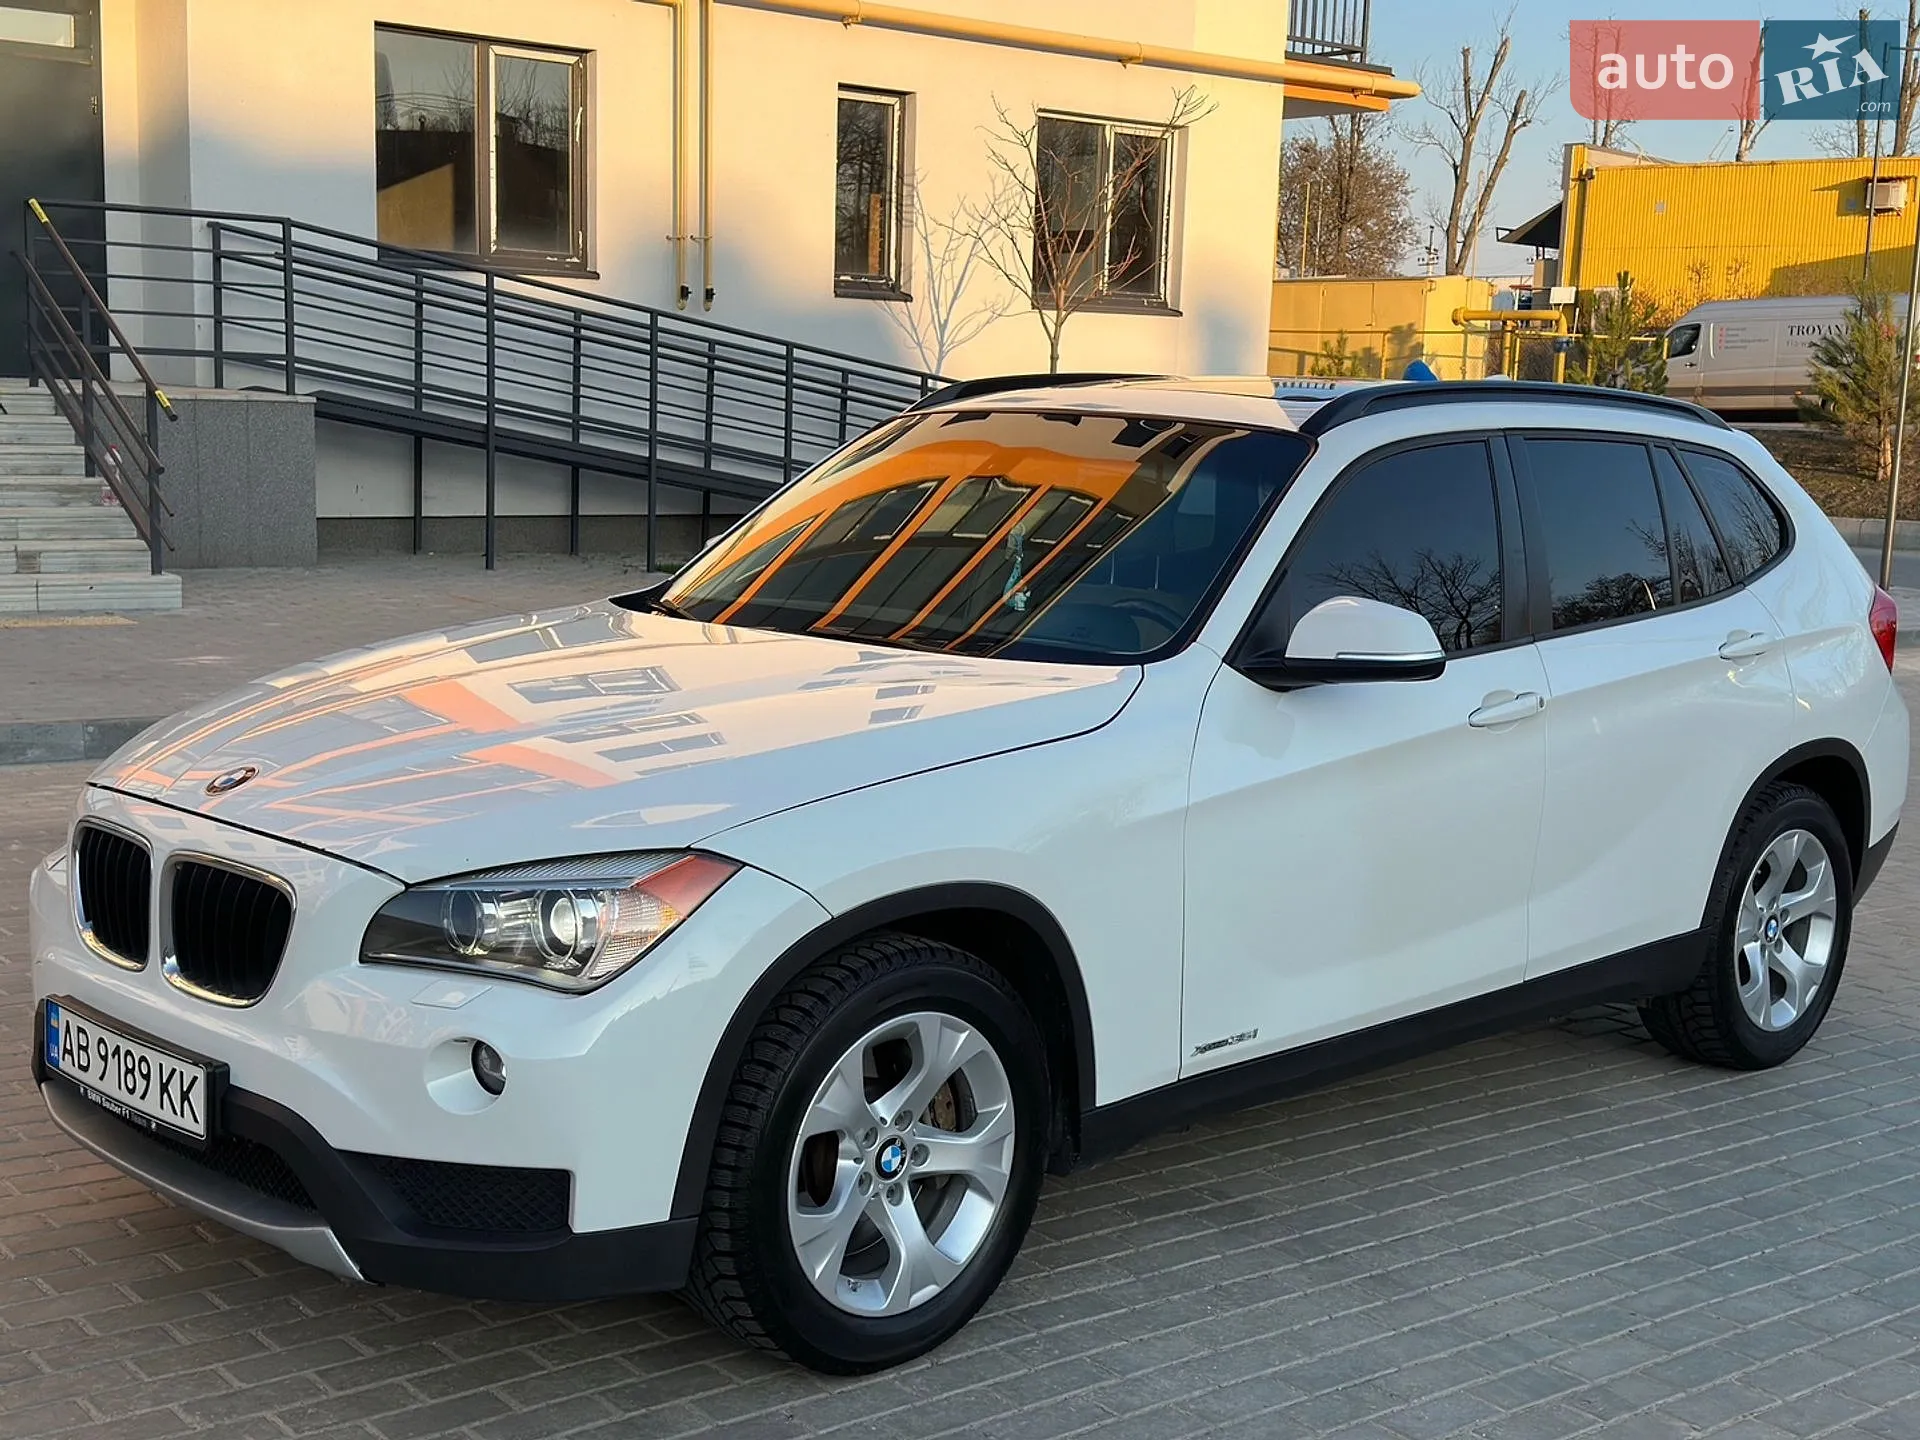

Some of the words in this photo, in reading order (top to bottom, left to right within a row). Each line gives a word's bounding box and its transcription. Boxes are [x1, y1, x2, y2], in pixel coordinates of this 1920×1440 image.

[62, 1019, 91, 1073] AB
[97, 1036, 151, 1101] 9189
[158, 1062, 200, 1125] KK
